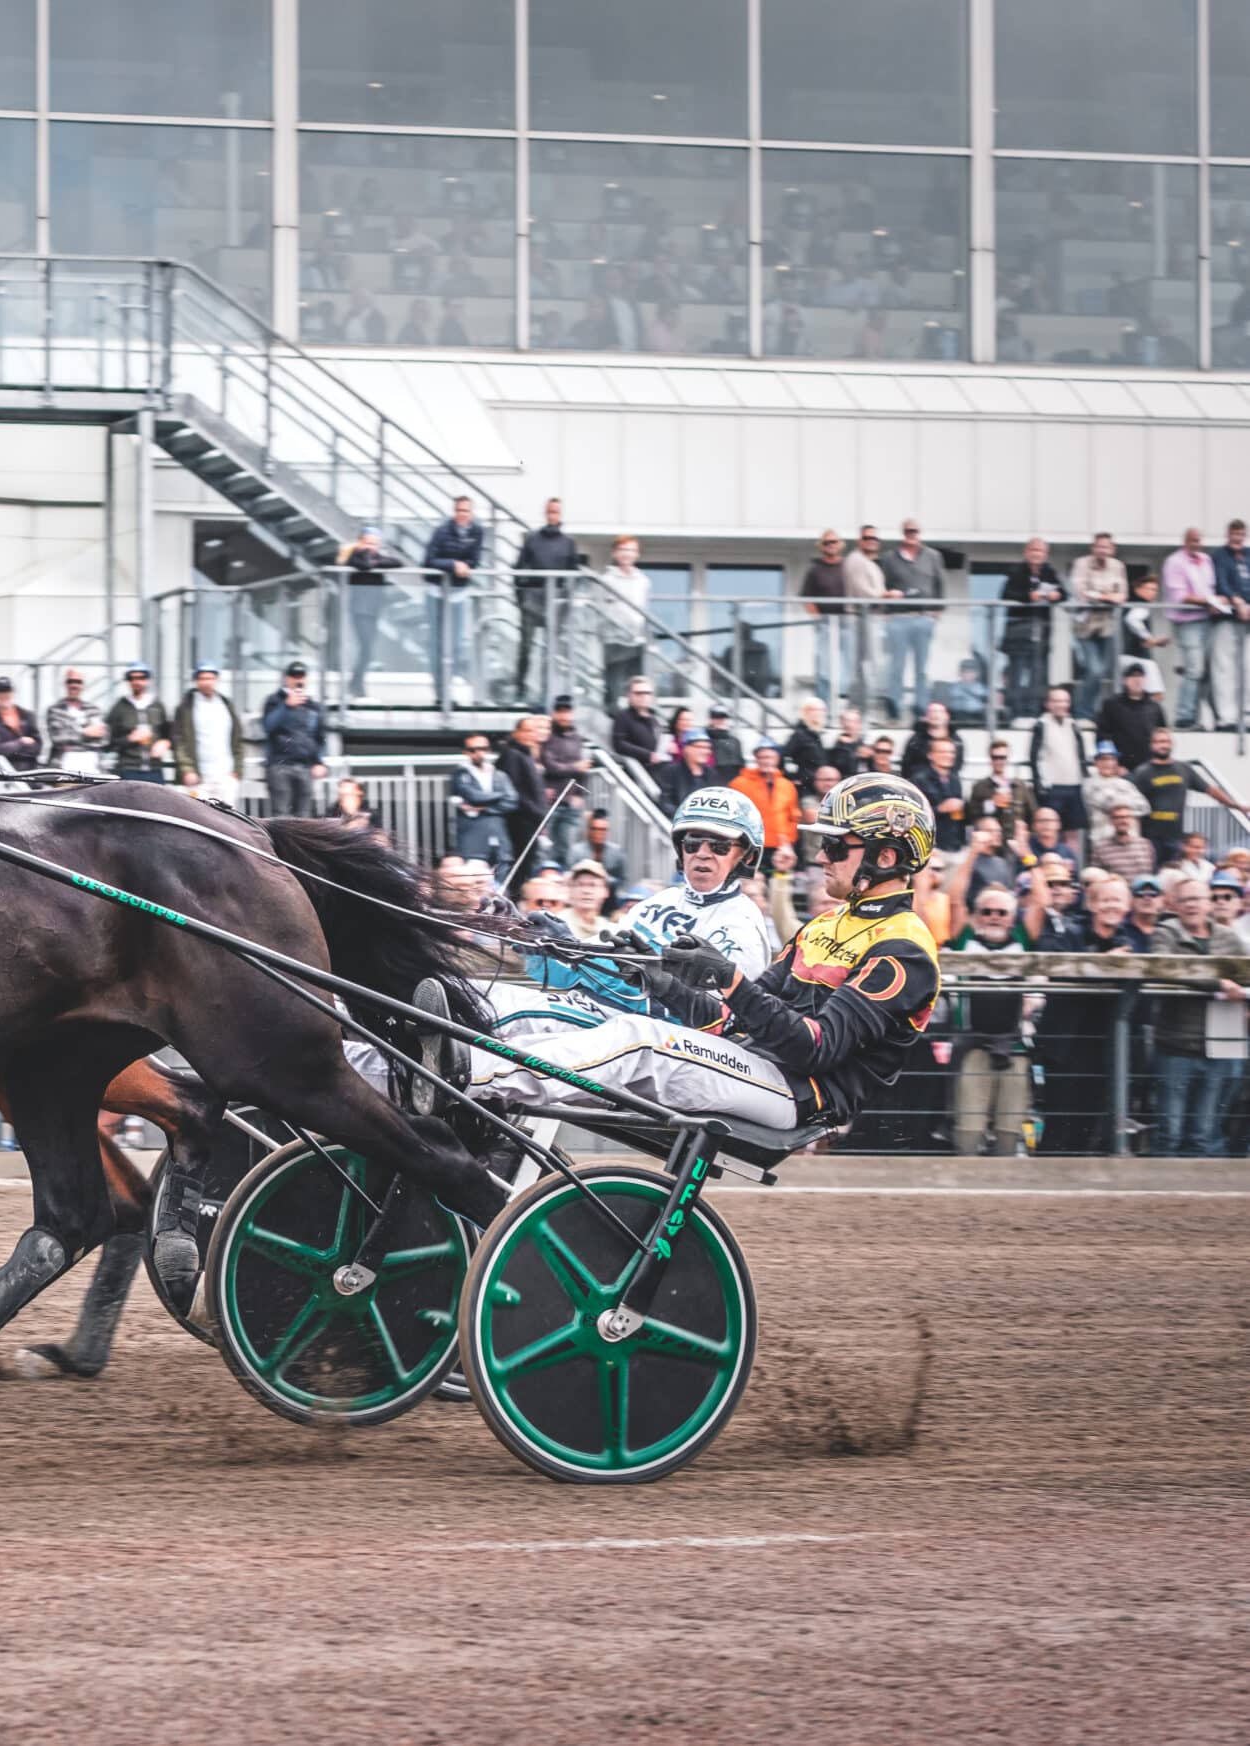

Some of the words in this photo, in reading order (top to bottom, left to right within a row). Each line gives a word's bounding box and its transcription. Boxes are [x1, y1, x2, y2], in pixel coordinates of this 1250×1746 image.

[689, 797, 731, 811] SVEA
[72, 873, 118, 897] UFO
[118, 893, 187, 925] ECLIPSE
[683, 1039, 751, 1076] Ramudden
